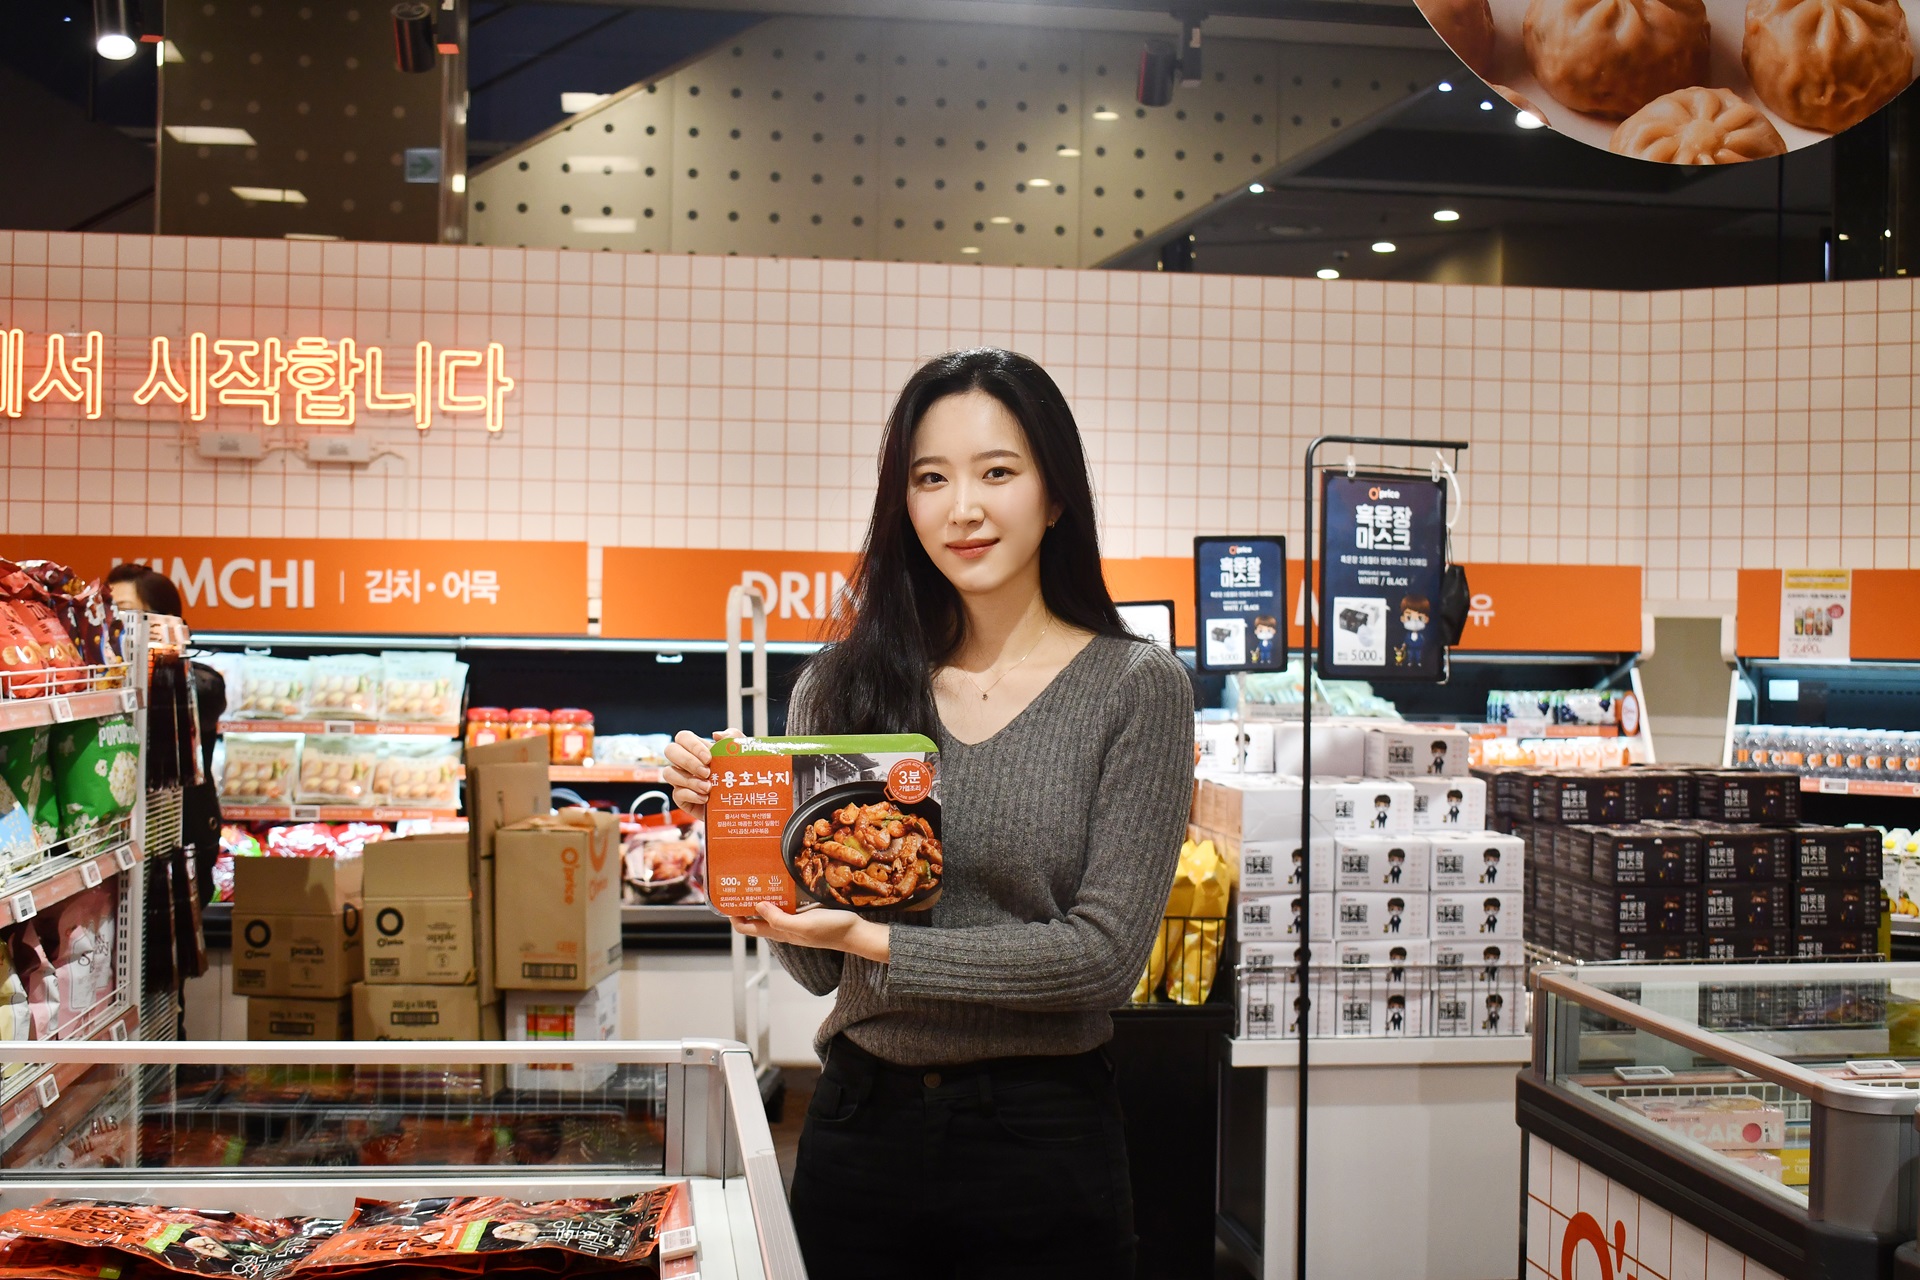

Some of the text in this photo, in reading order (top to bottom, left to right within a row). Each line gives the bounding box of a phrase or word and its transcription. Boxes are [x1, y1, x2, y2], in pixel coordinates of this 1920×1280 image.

[134, 332, 514, 432] 시작합니다
[1356, 504, 1413, 528] 흑운장
[1356, 527, 1411, 551] 마스크
[1220, 556, 1261, 572] 흑운장
[1220, 572, 1261, 588] 마스크
[1358, 577, 1379, 585] WHITE
[1386, 577, 1408, 586] BLACK
[899, 770, 921, 785] 3분
[720, 792, 779, 806] 낙곱새볶음
[721, 877, 741, 886] 300g
